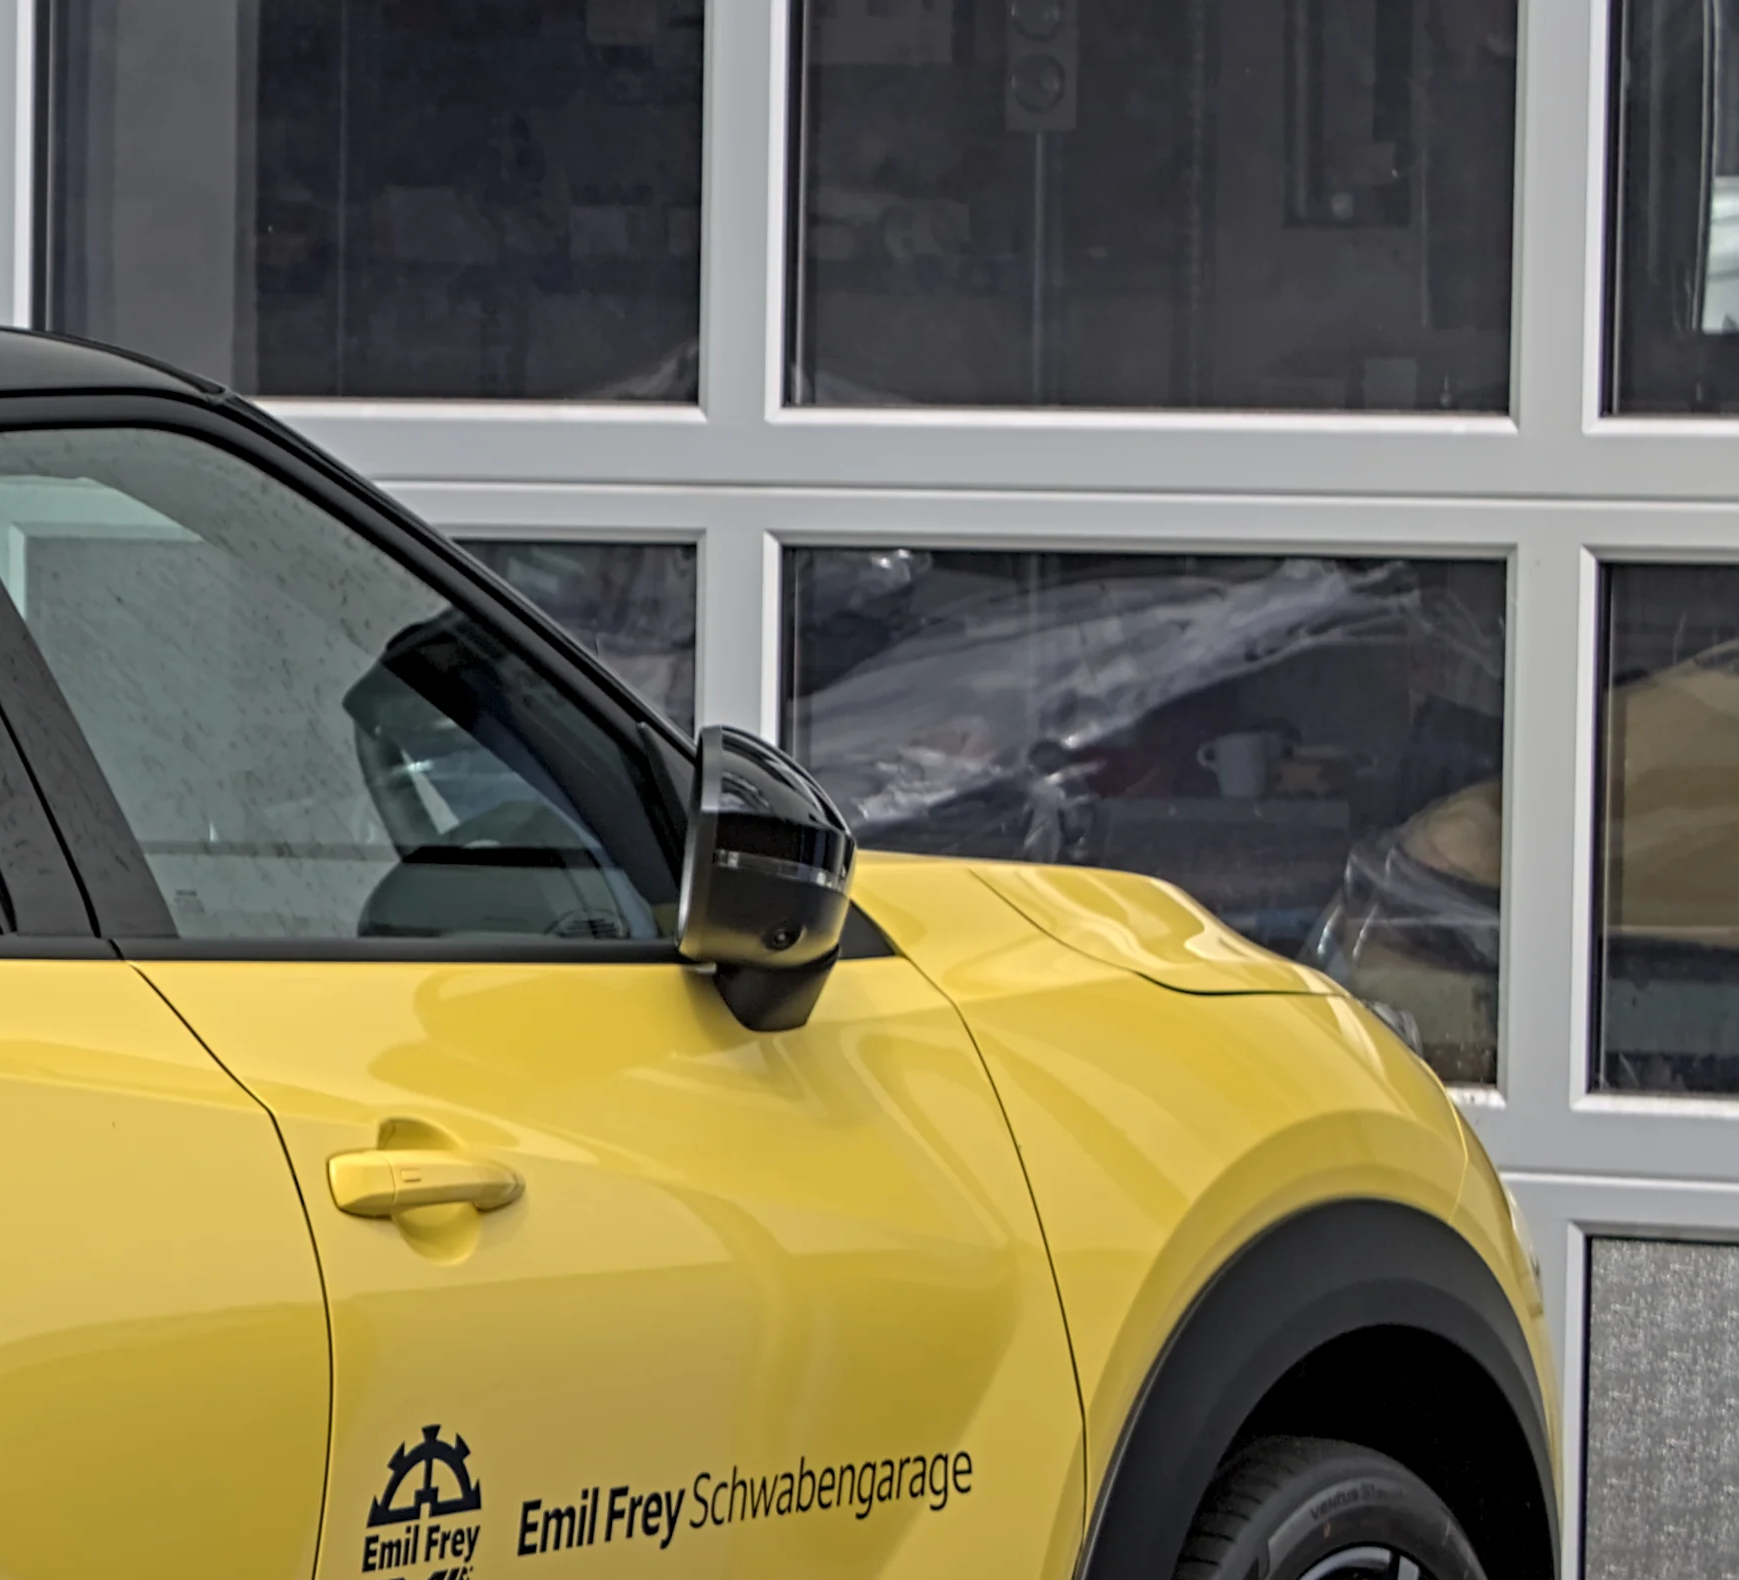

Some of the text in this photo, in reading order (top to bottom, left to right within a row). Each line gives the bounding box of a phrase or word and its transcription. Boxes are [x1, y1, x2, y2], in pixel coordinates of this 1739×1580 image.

[517, 1449, 973, 1557] Emil Frey Schwabengarage
[362, 1524, 481, 1573] Emil Frey
